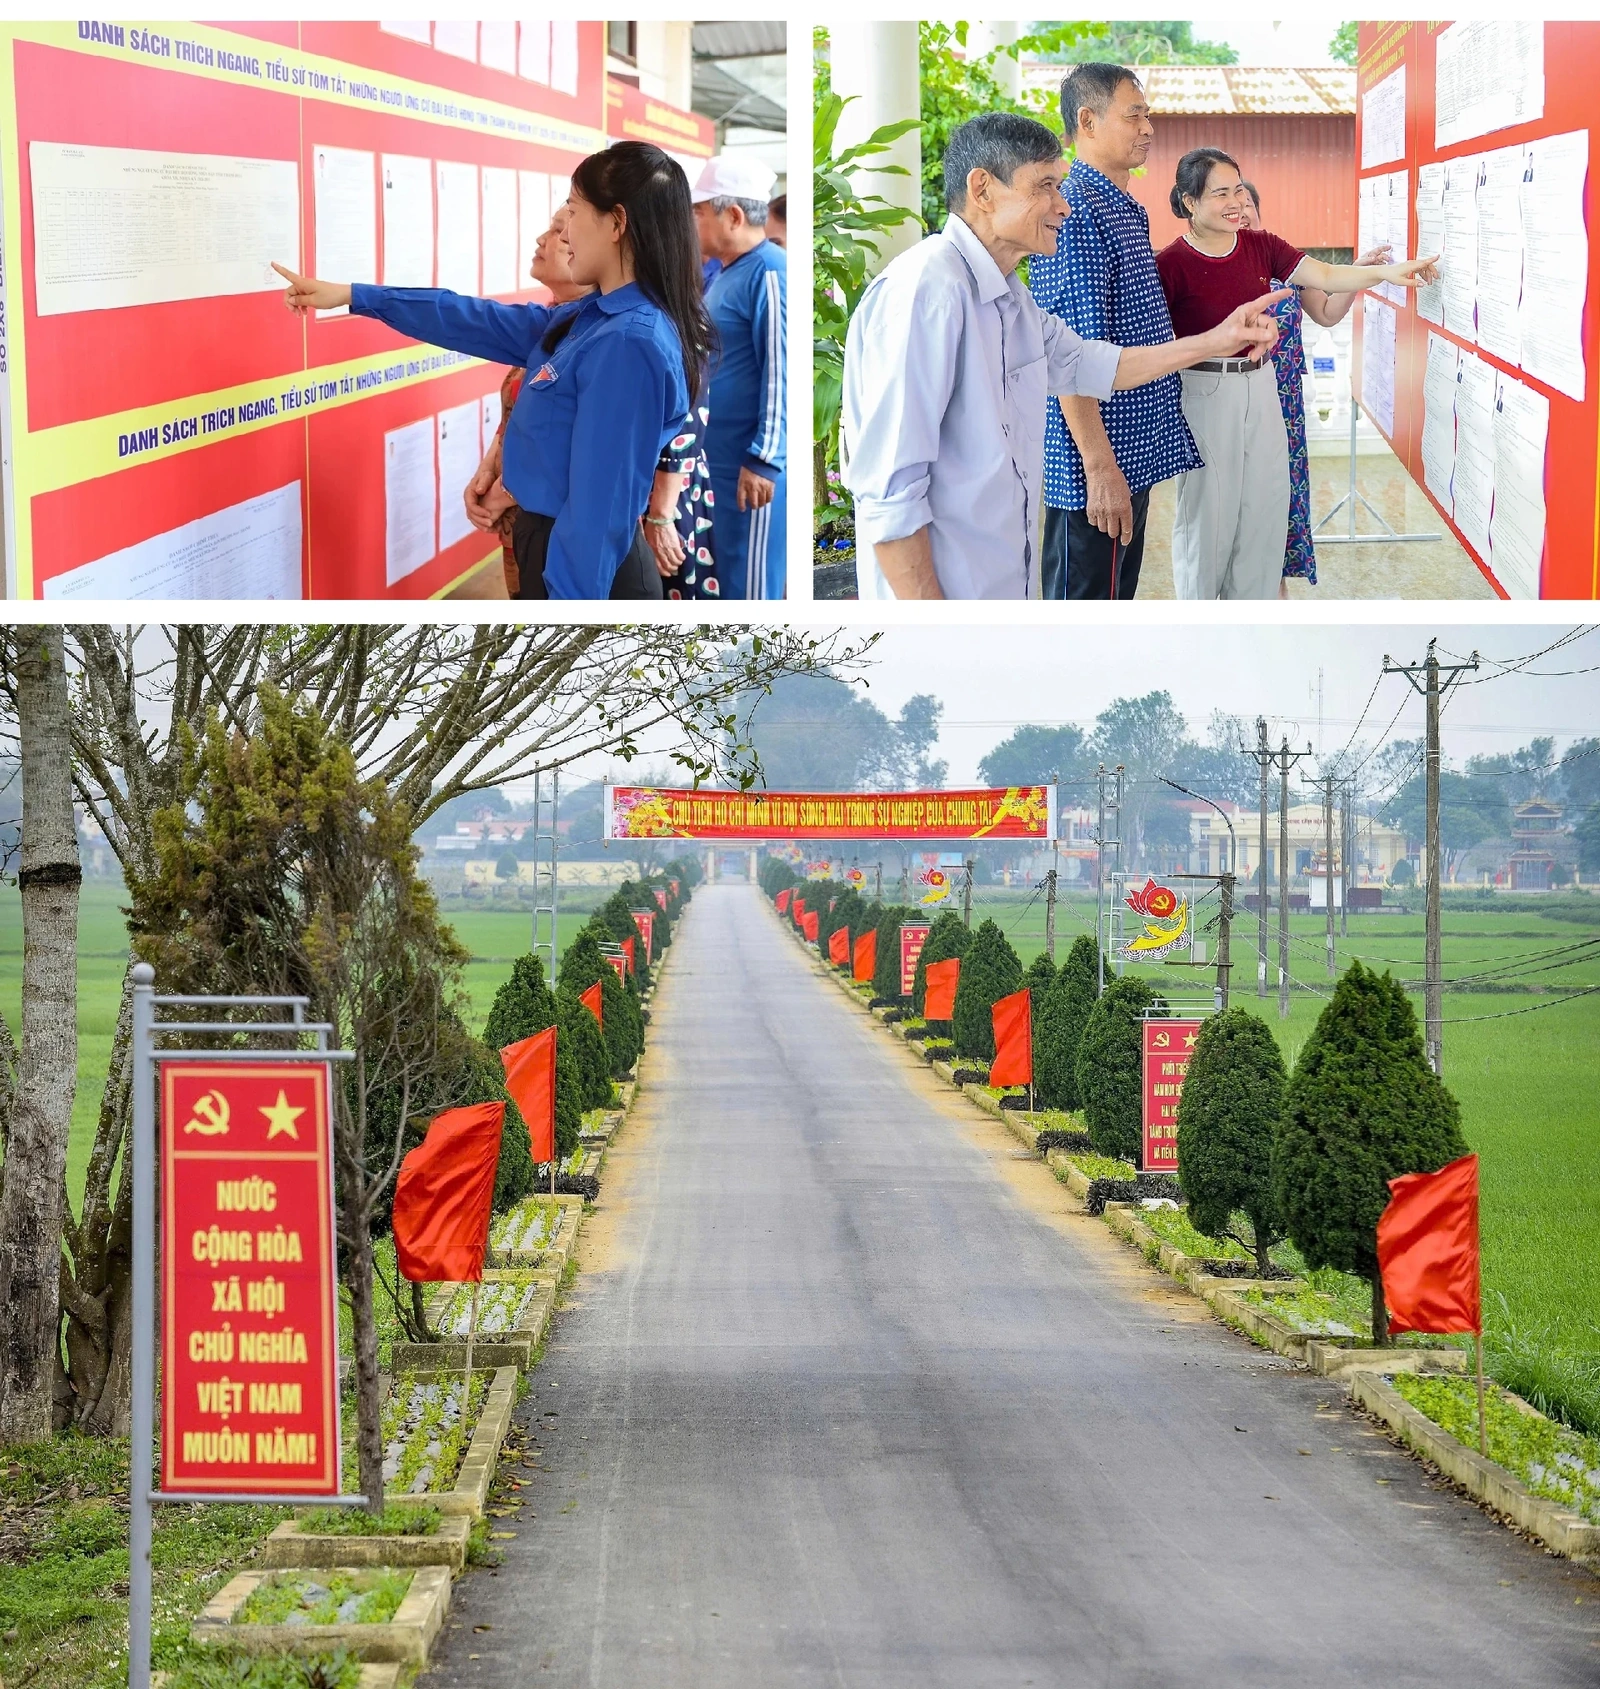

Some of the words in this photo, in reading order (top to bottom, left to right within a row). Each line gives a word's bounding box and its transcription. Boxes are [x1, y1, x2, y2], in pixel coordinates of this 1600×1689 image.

[78, 21, 125, 47] DANH
[130, 28, 170, 57] SÁCH
[175, 40, 214, 66] TRÍCH
[217, 51, 262, 79] NGANG,
[266, 58, 289, 82] TIỂU
[292, 66, 306, 85] SỬ
[308, 70, 329, 91] TÓM
[331, 74, 346, 94] TẮT
[350, 82, 377, 101] NHỮNG
[118, 427, 159, 457] DANH
[162, 418, 198, 445] SÁCH
[201, 407, 235, 434] TRÍCH
[238, 397, 278, 423] NGANG,
[281, 384, 302, 411] TIỂU
[304, 381, 317, 405] SỬ
[319, 380, 337, 400] TÓM
[340, 373, 353, 394] TẮT
[356, 369, 382, 391] NHỮNG
[673, 794, 691, 826] CHỦ
[692, 800, 712, 831] TỊCH
[715, 795, 727, 826] HỒ
[729, 796, 744, 826] CHÍ
[747, 801, 770, 826] MINH
[772, 797, 781, 826] VĨ
[783, 801, 798, 832] ĐẠI
[800, 796, 825, 826] SỐNG
[826, 798, 844, 826] MÃI
[846, 801, 875, 826] TRONG
[877, 801, 890, 832] SỰ
[892, 798, 924, 832] NGHIỆP
[926, 795, 945, 826] CỦA
[947, 797, 977, 826] CHÚNG
[979, 801, 992, 826] TA!
[1162, 1060, 1175, 1076] PHÁT
[1161, 1143, 1173, 1159] TIẾN
[216, 1179, 277, 1212] NƯỚC
[192, 1225, 252, 1268] CỘNG
[256, 1224, 303, 1262] HÒA
[211, 1276, 241, 1312] XÃ
[246, 1276, 285, 1318] HỘI
[188, 1322, 234, 1364] CHỦ
[239, 1327, 308, 1364] NGHĨA
[196, 1376, 244, 1420] VIỆT
[249, 1383, 303, 1414] NAM
[183, 1427, 250, 1465] MUÔN
[255, 1427, 317, 1465] NĂM!
